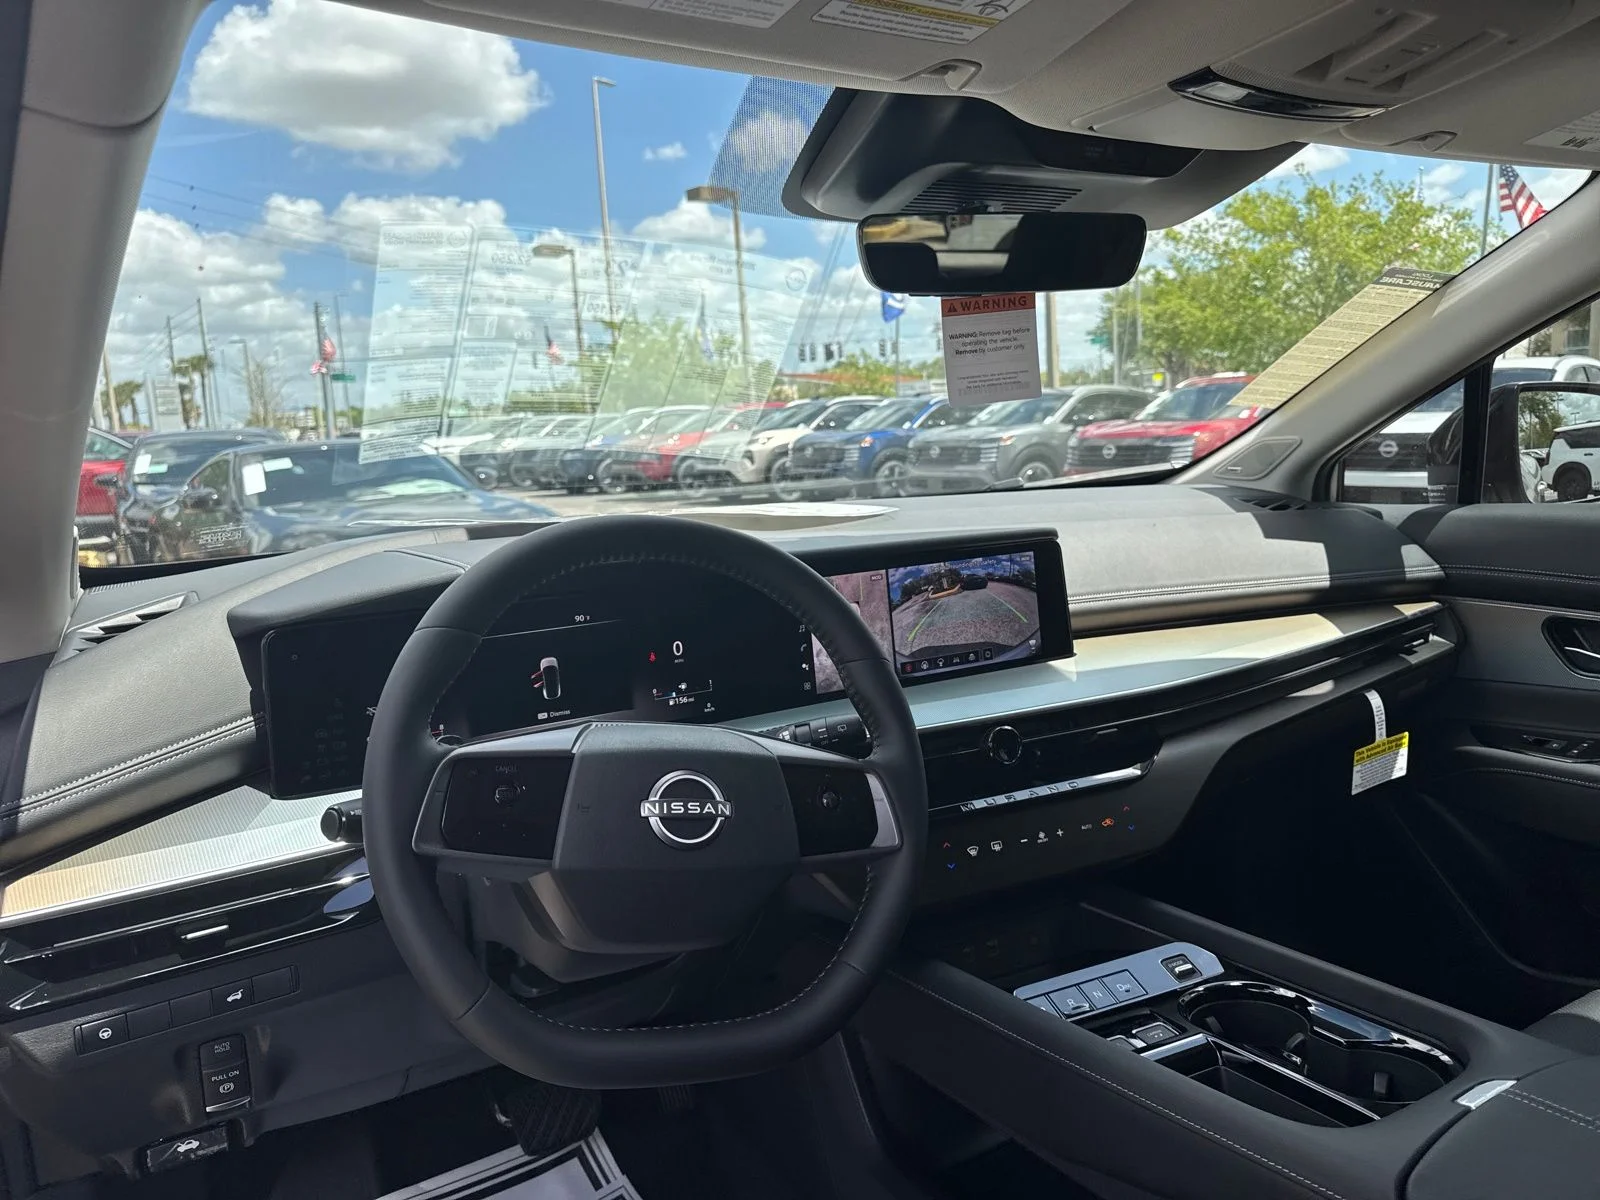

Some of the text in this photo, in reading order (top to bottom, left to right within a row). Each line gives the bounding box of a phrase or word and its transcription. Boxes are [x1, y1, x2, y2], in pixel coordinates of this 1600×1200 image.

[960, 296, 1027, 311] WARNING
[948, 332, 978, 340] WARNING:
[962, 340, 988, 348] operating
[956, 348, 978, 356] Remove
[987, 345, 1012, 353] customer
[574, 614, 584, 622] 90
[672, 640, 683, 656] 0
[675, 696, 688, 704] 156
[960, 782, 1079, 812] MURANO
[644, 802, 730, 815] NISSAN
[1092, 990, 1103, 998] N
[1066, 998, 1075, 1006] R
